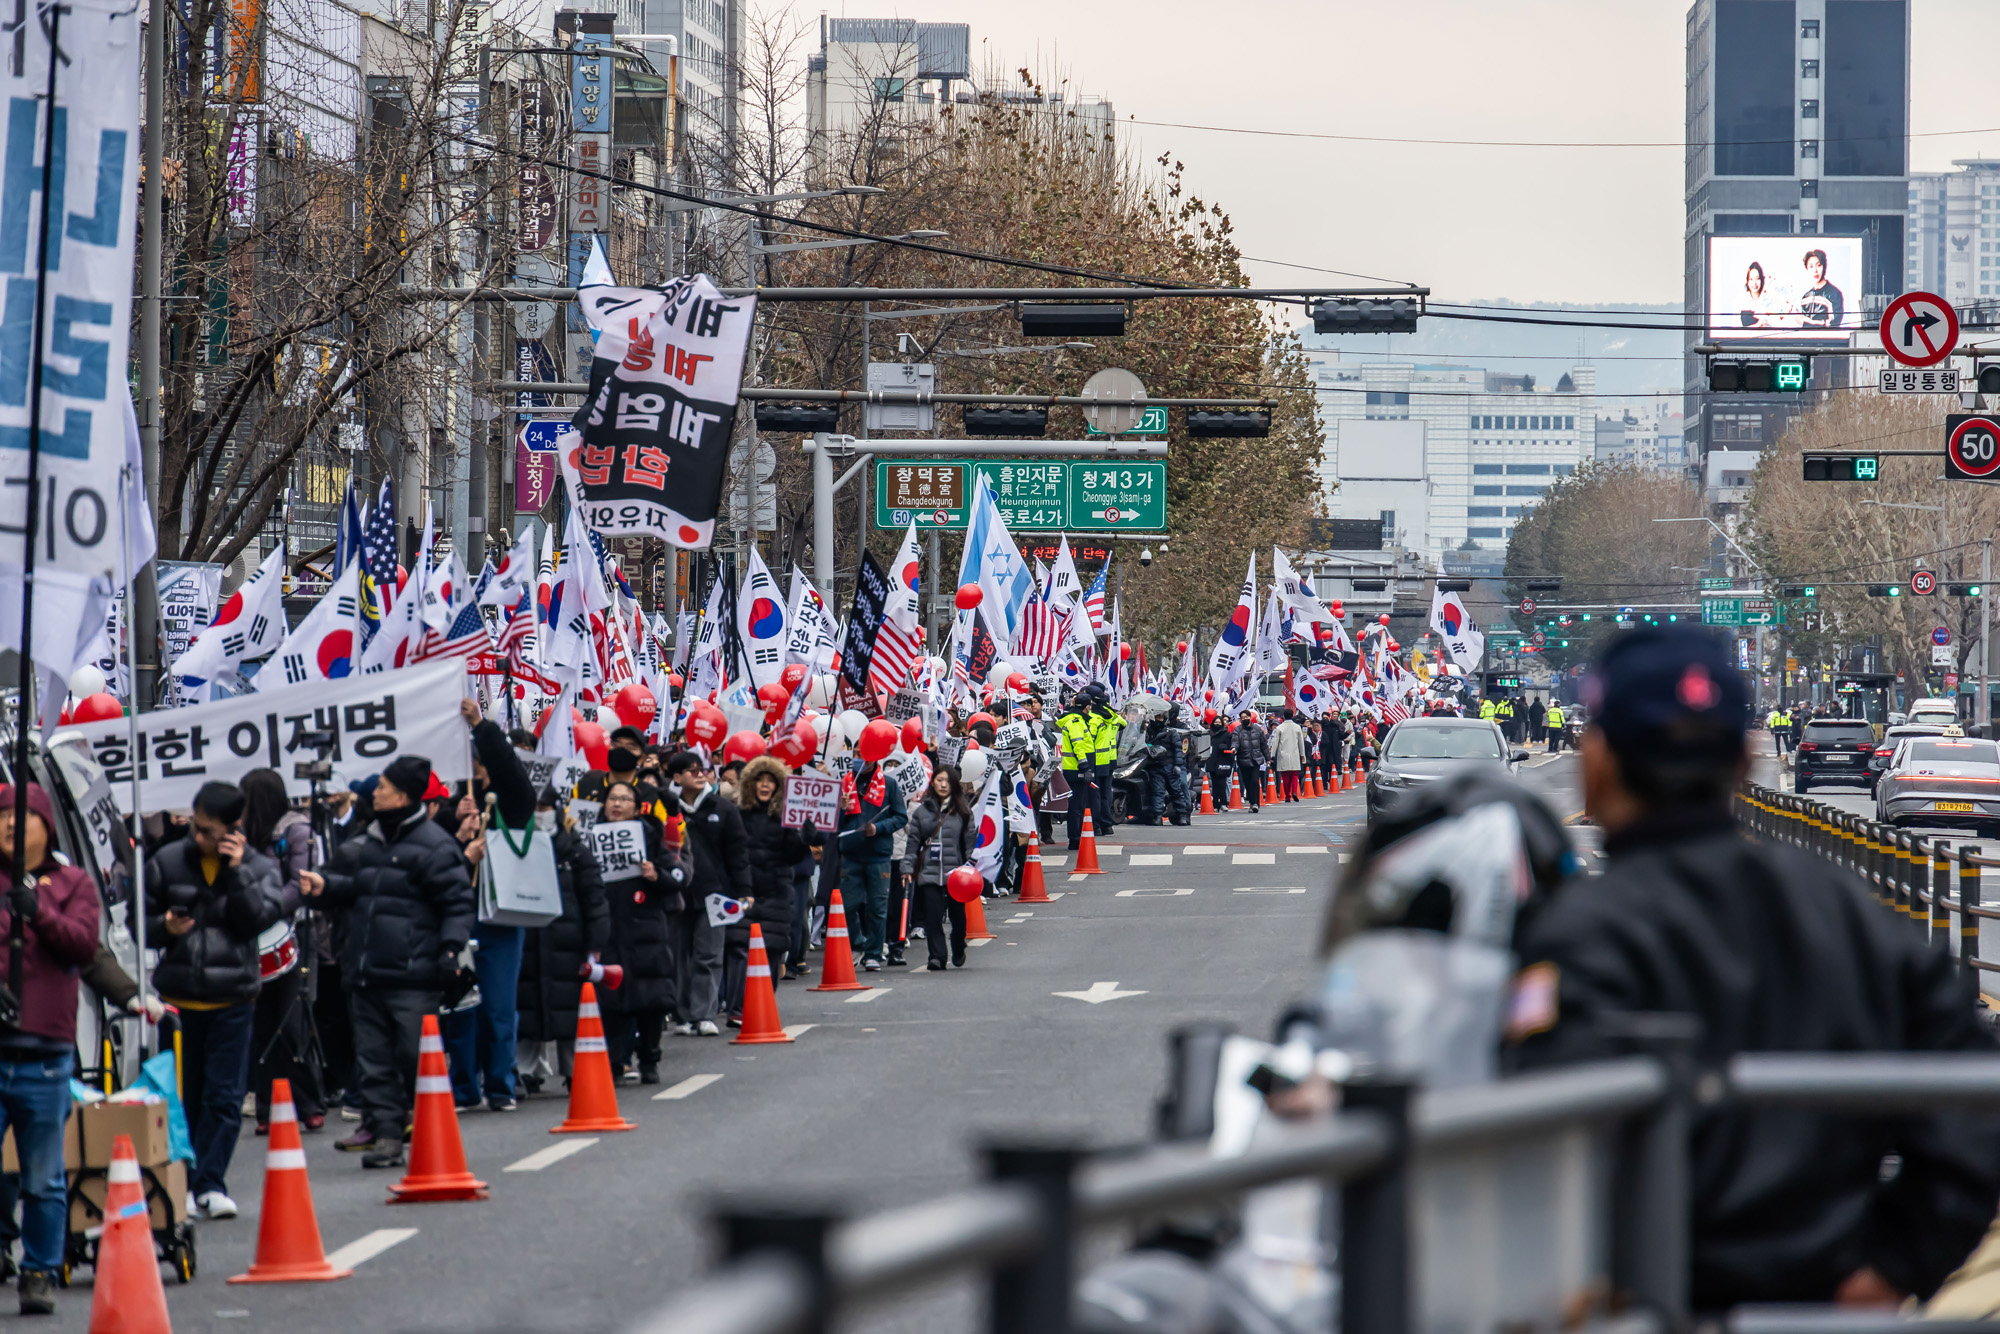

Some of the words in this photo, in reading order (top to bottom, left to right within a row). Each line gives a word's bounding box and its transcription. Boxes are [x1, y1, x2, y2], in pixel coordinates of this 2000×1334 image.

[1883, 372, 1955, 390] 일방통행
[530, 432, 543, 442] 24
[1962, 434, 1994, 460] 50
[526, 453, 545, 509] 보청기
[896, 467, 954, 482] 창덕궁
[1000, 466, 1062, 483] 흥인지문
[1082, 471, 1153, 489] 청계3가
[898, 484, 952, 496] 昌德宮
[1001, 484, 1057, 496] 興仁之門
[897, 496, 953, 508] Changdeokgung
[1001, 498, 1061, 508] Heunginjimun
[1082, 491, 1118, 505] Cheonggye
[895, 512, 908, 524] 50
[1000, 508, 1062, 526] 종로4가
[1034, 546, 1076, 558] 상관이
[1917, 578, 1930, 588] 50
[844, 692, 872, 703] KOREA
[894, 692, 920, 709] 계엄은
[848, 700, 873, 710] GREAT
[228, 696, 398, 768] 이재명
[794, 781, 834, 798] STOP
[802, 798, 819, 808] THE
[788, 808, 832, 826] STEAL
